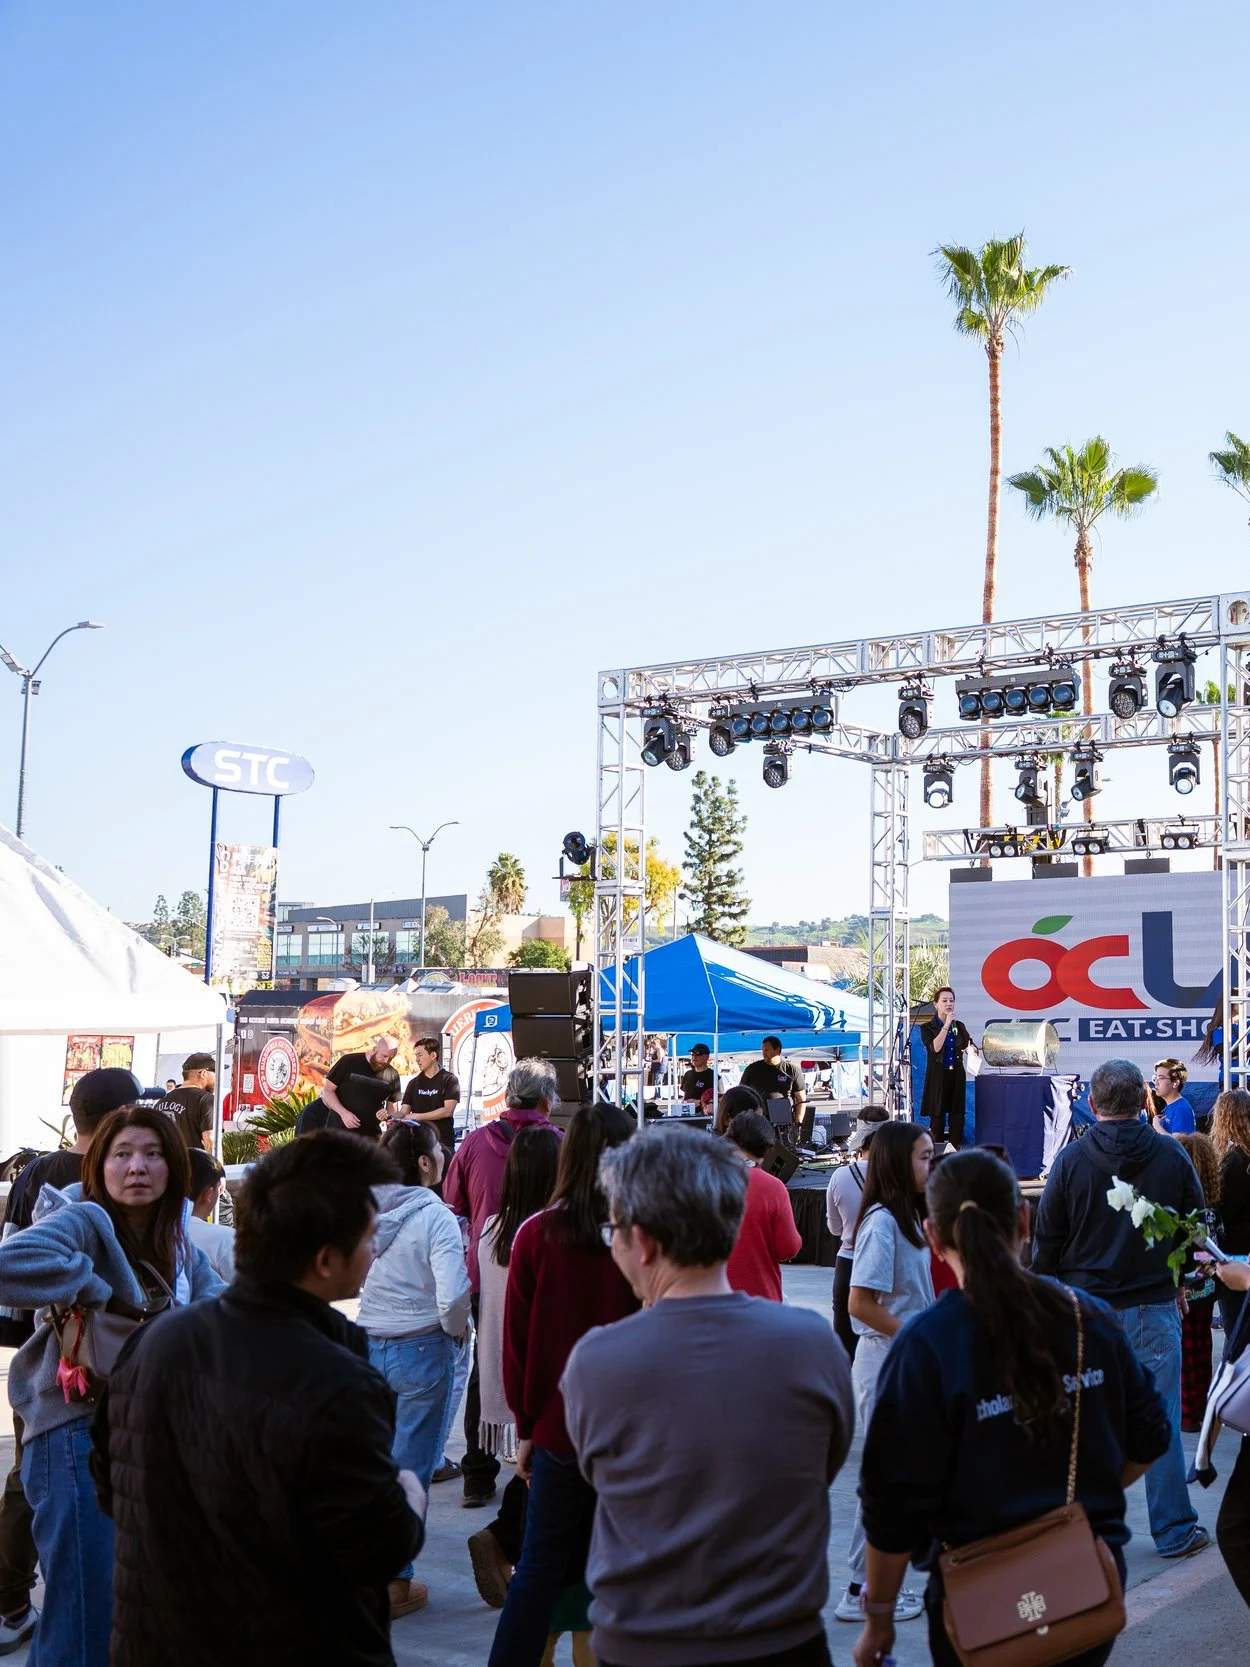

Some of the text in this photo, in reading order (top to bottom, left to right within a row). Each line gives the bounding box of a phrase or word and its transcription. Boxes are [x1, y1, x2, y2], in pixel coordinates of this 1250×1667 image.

[214, 749, 290, 789] STC
[157, 1102, 186, 1114] ULOGY
[1063, 1368, 1104, 1393] Sevice
